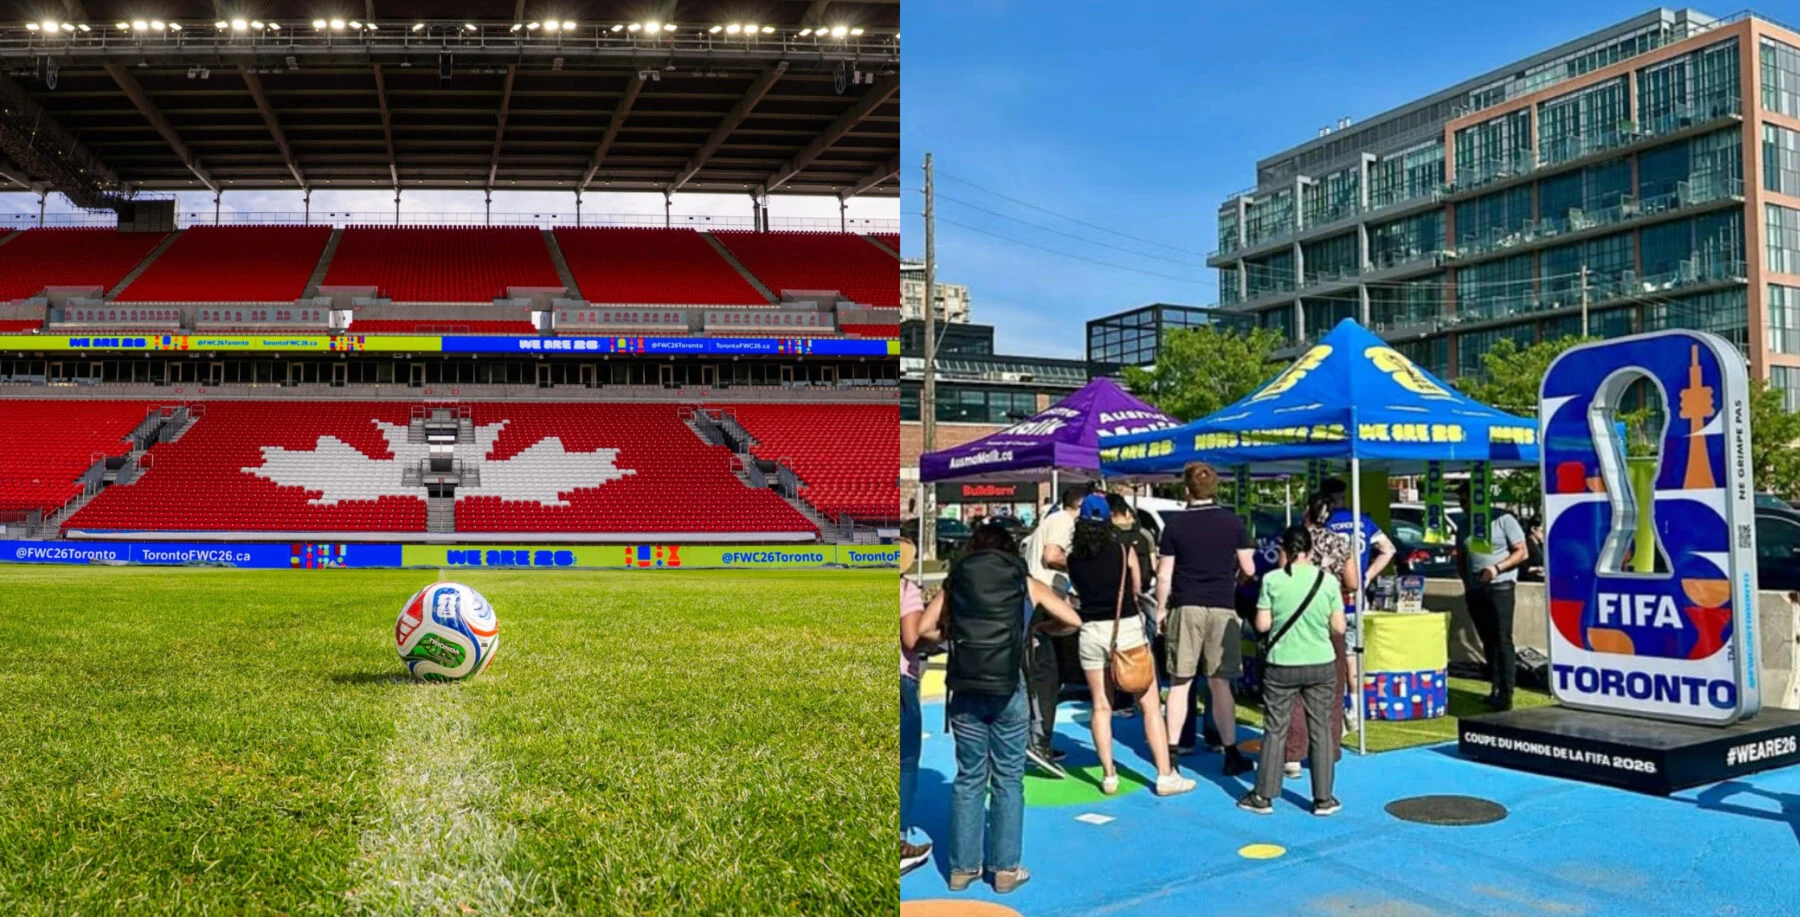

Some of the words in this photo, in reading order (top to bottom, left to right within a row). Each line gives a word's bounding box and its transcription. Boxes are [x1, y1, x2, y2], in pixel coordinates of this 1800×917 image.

[197, 339, 249, 347] @FWC26Toronto
[519, 339, 541, 349] WE
[543, 340, 571, 349] ARE
[1099, 410, 1169, 424] Ausma
[1735, 400, 1743, 423] PAS
[1358, 423, 1390, 441] WE
[1736, 428, 1745, 478] GRIMPE
[1738, 482, 1746, 500] NE
[16, 547, 116, 560] @FWC26Toronto
[142, 549, 251, 561] TorontoFWC26.ca
[447, 549, 482, 565] WE
[486, 550, 530, 565] ARE
[534, 550, 574, 566] 26
[722, 551, 823, 564] @FWC26Toronto
[1598, 592, 1684, 629] FIFA
[1552, 663, 1737, 709] TORONTO
[1464, 732, 1497, 747] COUPE
[1498, 738, 1512, 750] DU
[1514, 739, 1551, 756] MONDE
[1553, 747, 1567, 759] DE
[1569, 749, 1584, 762] LA
[1585, 752, 1611, 767] FIFA
[1612, 756, 1657, 773] 2026
[1727, 735, 1797, 766] #WEARE26
